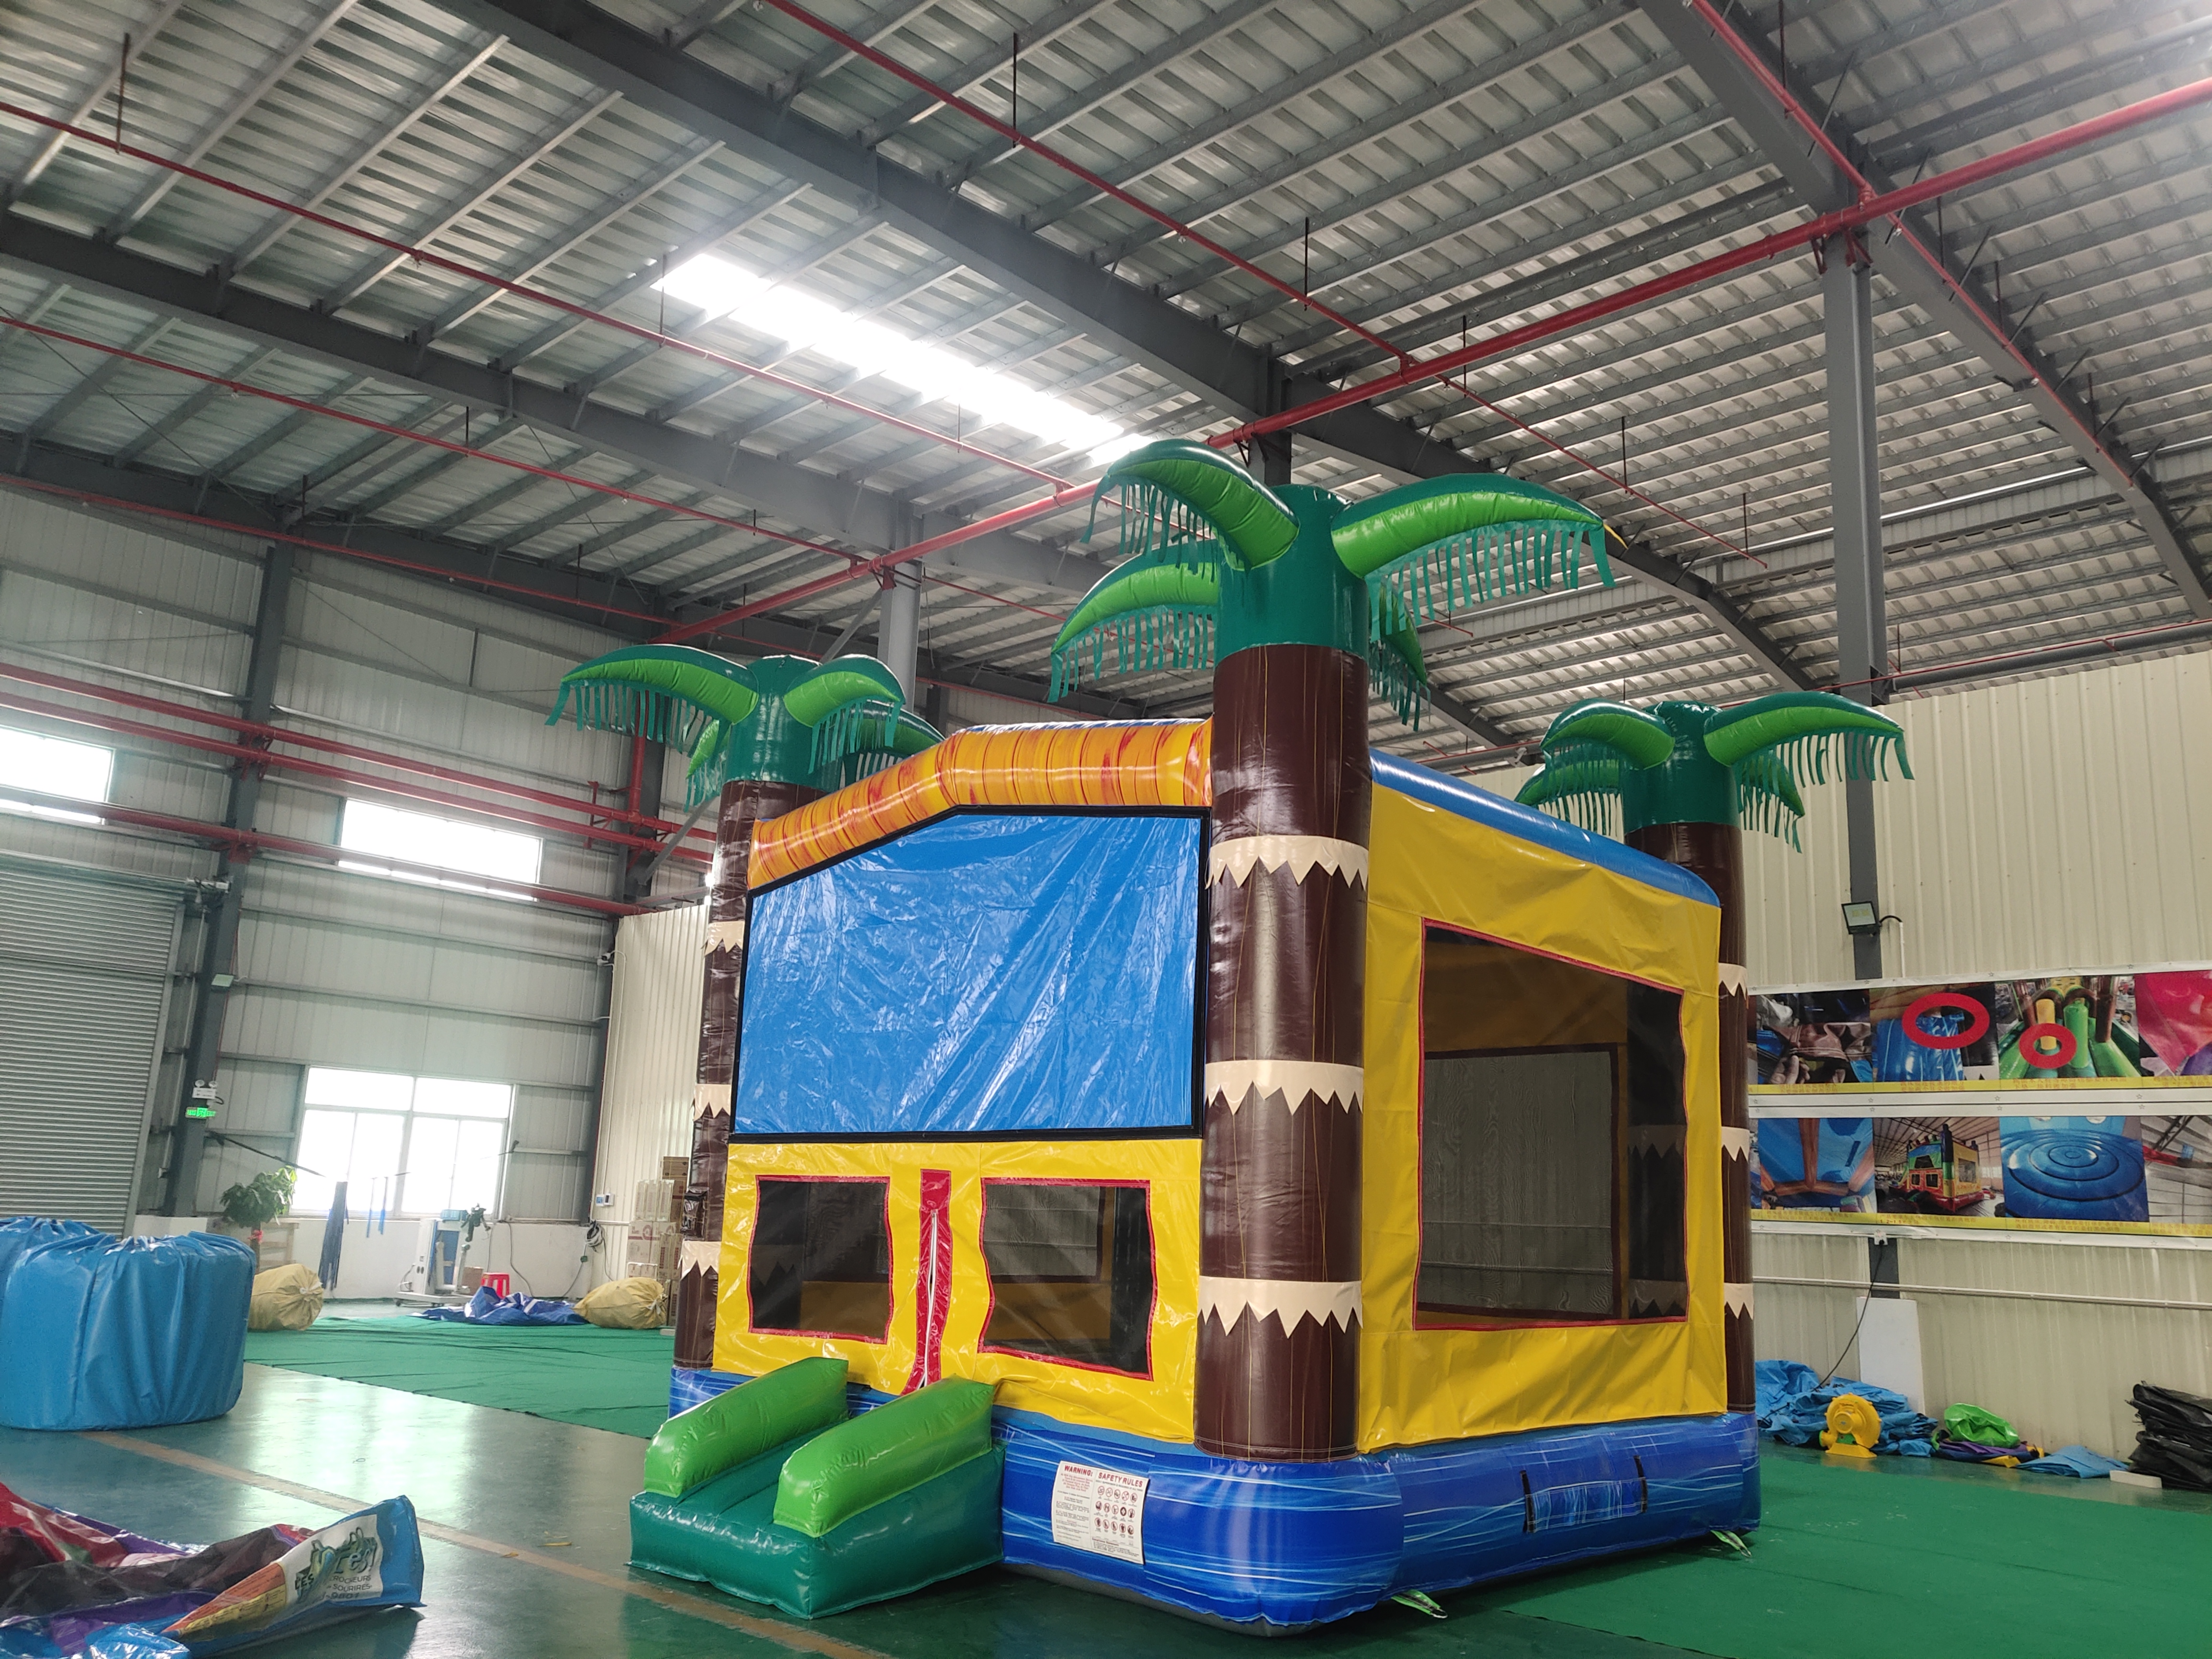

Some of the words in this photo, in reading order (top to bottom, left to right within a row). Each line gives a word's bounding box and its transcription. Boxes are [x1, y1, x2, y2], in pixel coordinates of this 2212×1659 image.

[1064, 1465, 1093, 1477] WARNING!
[1098, 1472, 1122, 1483] SAFETY
[1122, 1478, 1143, 1487] RULES
